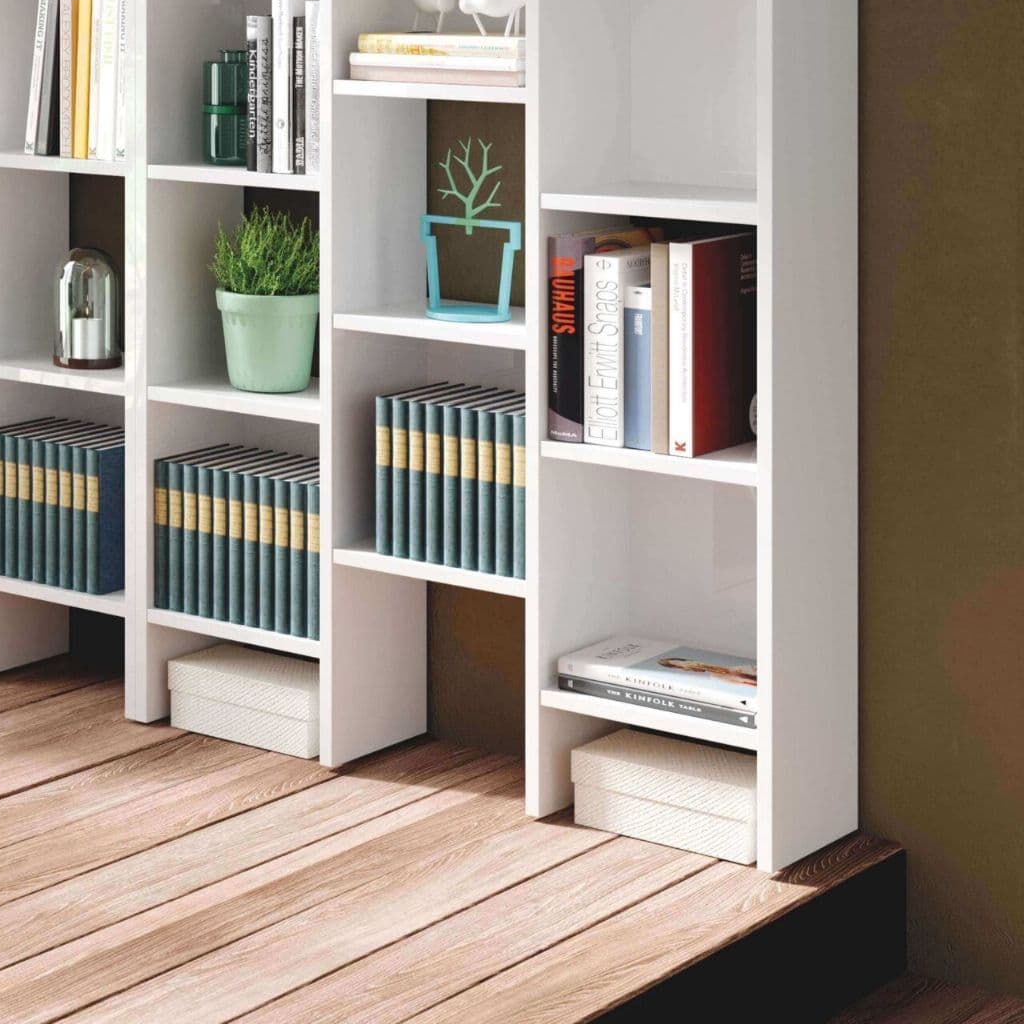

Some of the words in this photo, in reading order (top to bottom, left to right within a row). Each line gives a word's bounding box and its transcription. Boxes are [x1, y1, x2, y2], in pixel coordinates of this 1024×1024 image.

[35, 37, 44, 50] IT
[248, 49, 257, 137] Kindergarten
[551, 255, 576, 335] BAUHAUS
[587, 280, 624, 337] Snaps
[587, 340, 619, 391] Erwitt
[587, 394, 619, 442] Elliott
[625, 676, 674, 690] KINFOLK
[625, 692, 675, 708] KINFOLK
[679, 704, 702, 713] TABLE
